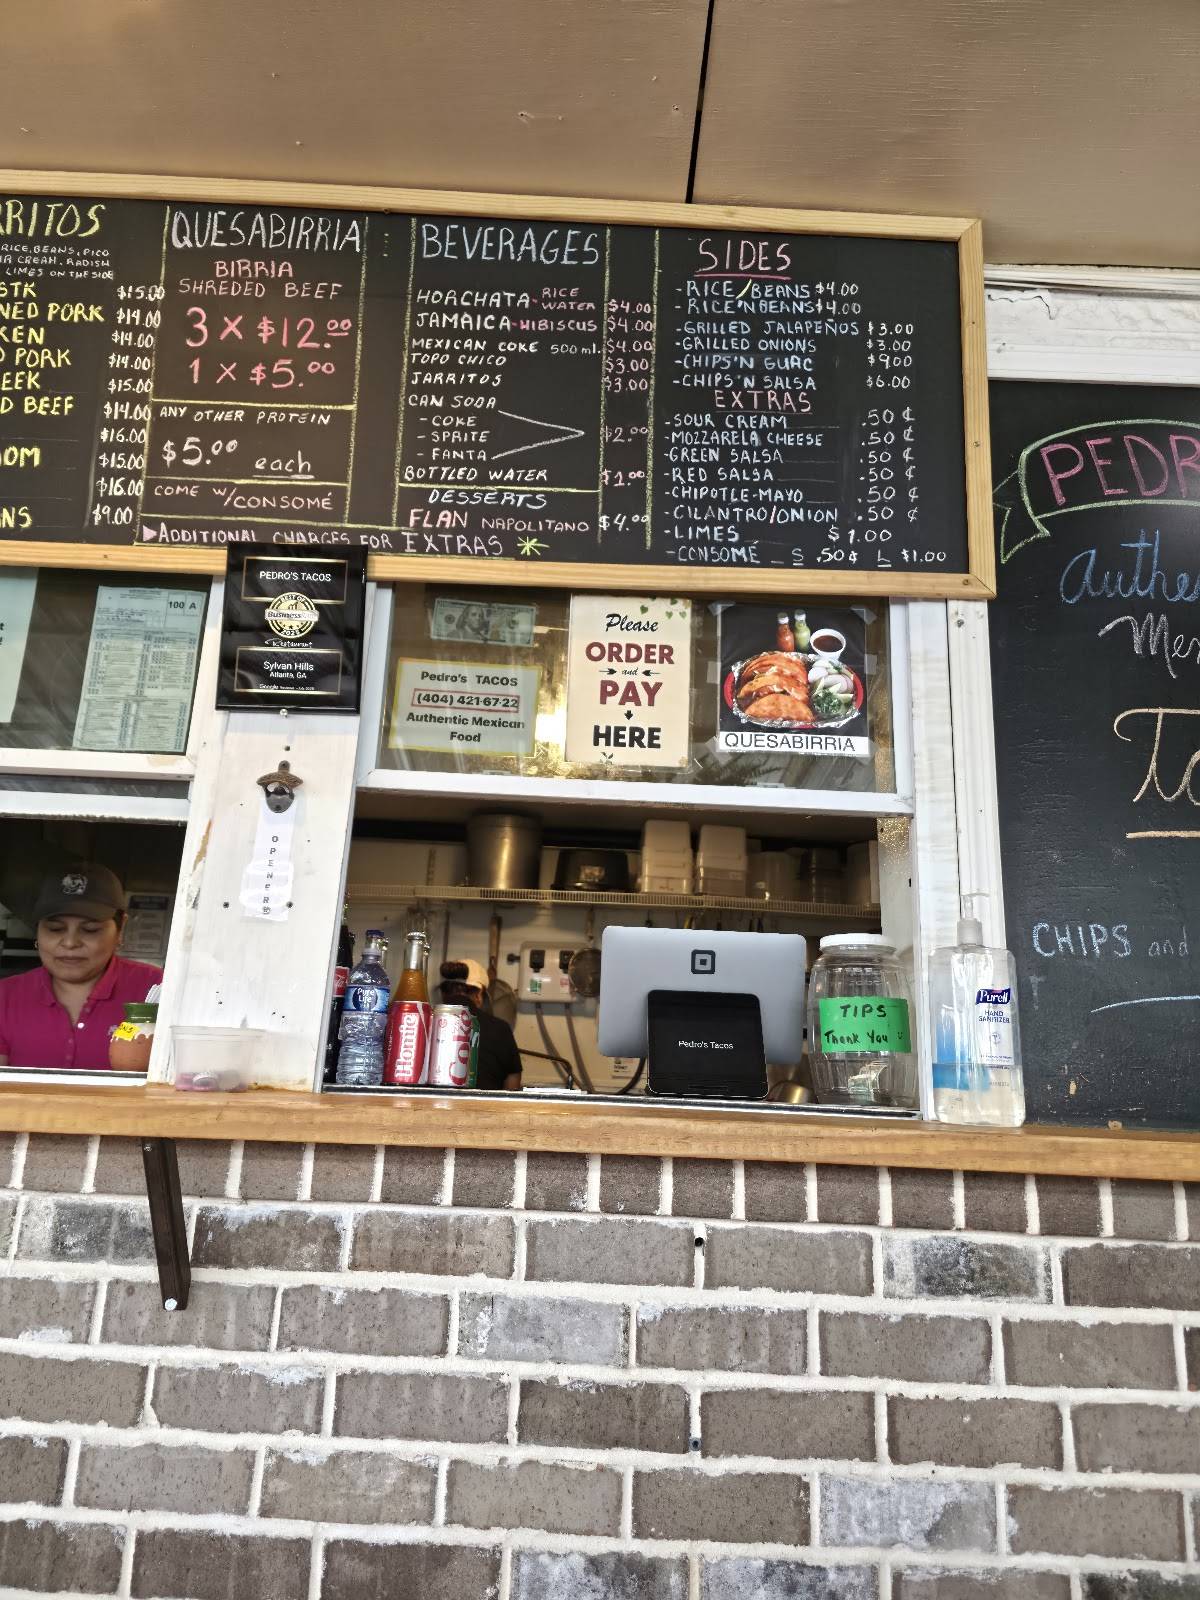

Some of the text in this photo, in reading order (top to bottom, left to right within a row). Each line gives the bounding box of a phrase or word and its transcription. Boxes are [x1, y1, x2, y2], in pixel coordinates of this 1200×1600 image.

[0, 199, 106, 237] RITOS
[171, 210, 361, 253] QUESABIRRIA
[421, 223, 599, 265] BEVERAGES
[696, 238, 791, 273] SIDES
[215, 260, 293, 278] BIRRIA
[117, 285, 166, 301] $15.00
[179, 279, 342, 299] SHREDED BEEF
[815, 281, 858, 297] $4.00
[541, 301, 596, 311] WATER
[542, 287, 652, 314] RICE $4.00
[47, 303, 104, 322] PORK
[116, 307, 161, 328] $14.00
[186, 306, 208, 347] 3
[111, 330, 154, 348] $14.00
[411, 339, 486, 352] MEXICAN
[499, 341, 539, 353] COKE
[550, 344, 578, 355] 500
[606, 340, 653, 354] $4.00
[758, 339, 817, 353] ONIONS
[15, 348, 151, 370] PORK $14.00
[410, 353, 649, 374] TOPO CHICO $3.00
[764, 355, 813, 372] GUAC
[107, 378, 153, 394] $15.00
[411, 372, 502, 387] JARRITOS
[764, 375, 817, 390] SALSA
[24, 396, 74, 415] BEEF
[103, 402, 152, 420] $14.00
[408, 394, 497, 409] CAN SODA
[715, 390, 812, 413] EXTRAS
[160, 406, 331, 425] ANY OTHER PROTEIN
[725, 414, 787, 429] CREAM
[100, 427, 147, 443] $16.00
[767, 432, 824, 447] CHEESE
[0, 446, 145, 470] OM $15.00
[254, 450, 311, 474] each
[730, 448, 784, 464] SALSA
[404, 465, 478, 481] BOTTLED
[489, 468, 548, 481] WATER
[718, 468, 774, 481] SALSA
[154, 484, 200, 496] COME
[428, 489, 547, 510] DESSERTS
[92, 503, 133, 525] $9.00
[409, 508, 468, 529] FLAN
[481, 518, 589, 533] NAPOLITANO
[401, 531, 503, 556] EXTRAS
[259, 570, 332, 582] PEDRO'S TACOS
[167, 601, 197, 610] 100 A
[605, 613, 659, 632] Please
[585, 641, 675, 665] ORDER
[263, 660, 314, 672] Sylvan Hills
[621, 666, 639, 677] and
[296, 671, 307, 679] GA
[420, 670, 519, 687] Pedro's TACOS
[417, 692, 454, 706] (404)
[600, 680, 663, 707] PAY
[406, 711, 525, 729] Authentic Mexican
[449, 731, 482, 743] Food
[592, 725, 661, 749] HERE
[725, 732, 856, 752] QUESABIRRIA
[1032, 922, 1188, 959] CHIPS and
[357, 987, 375, 997] Pure
[840, 1003, 887, 1018] TIPS
[984, 1009, 1004, 1017] HAND
[678, 1040, 734, 1050] Pedro's Tacos
[824, 1029, 889, 1045] Thank You
